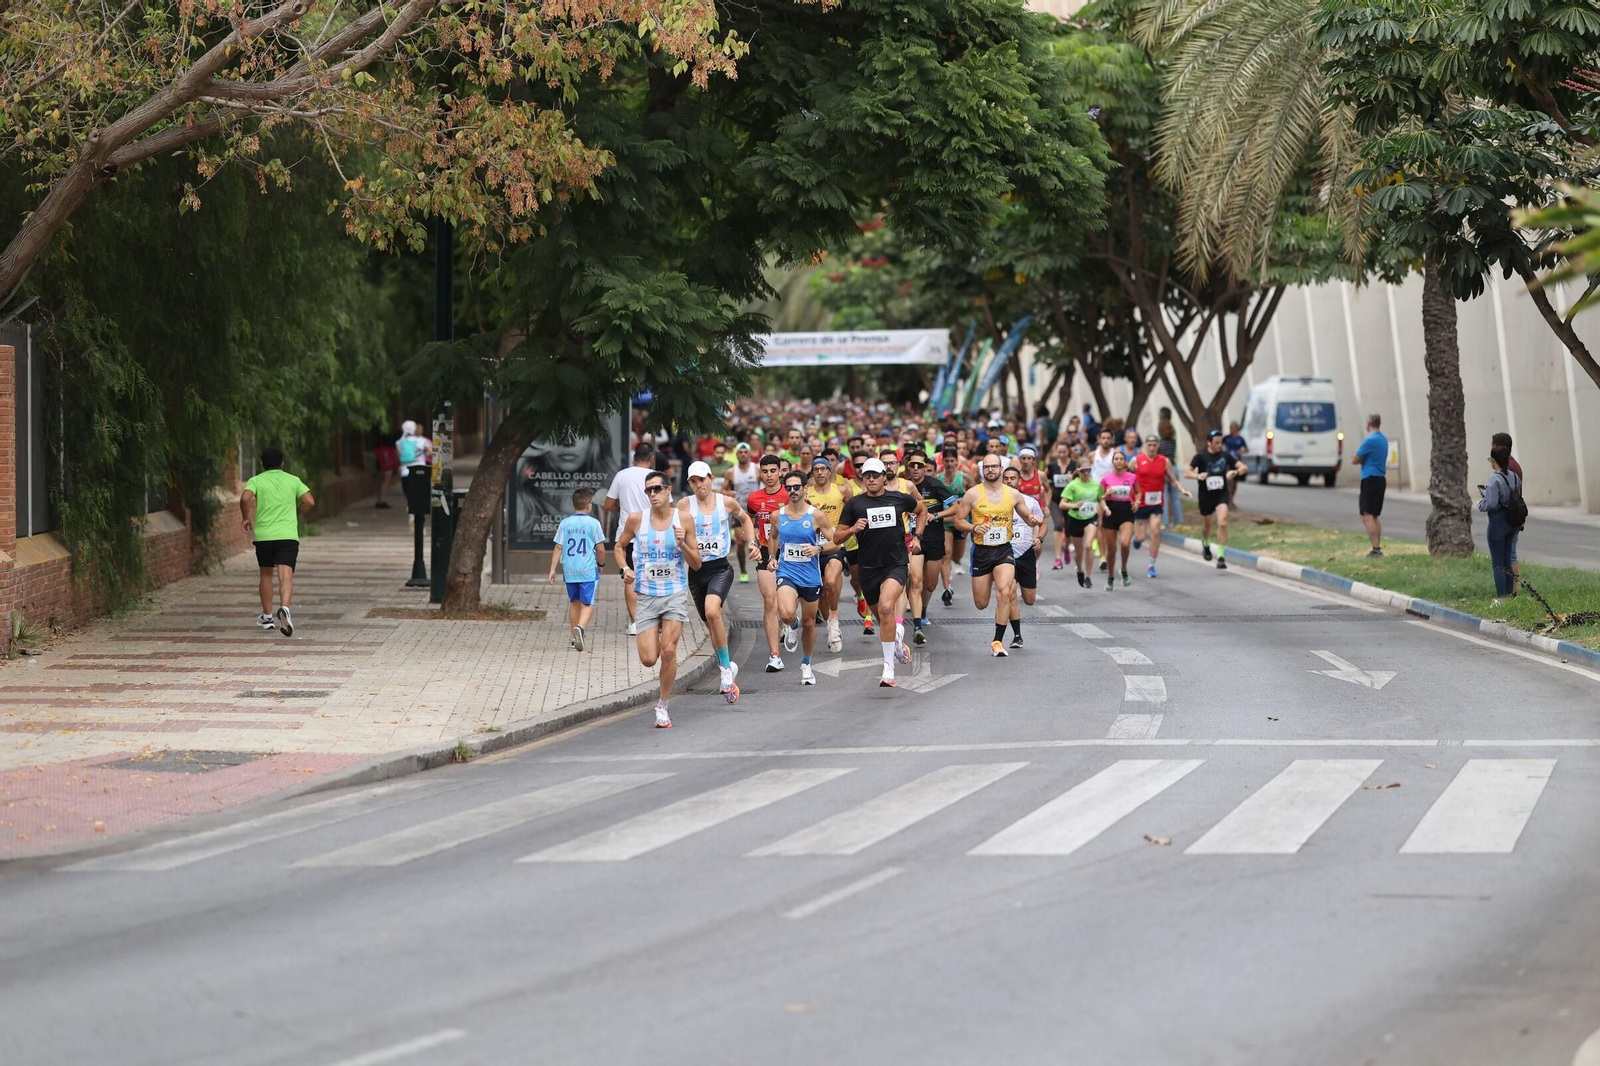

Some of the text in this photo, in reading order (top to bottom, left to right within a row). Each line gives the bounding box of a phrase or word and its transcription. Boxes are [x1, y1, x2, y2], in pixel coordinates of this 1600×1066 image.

[528, 472, 608, 480] CABELLO GLOSSY
[871, 513, 892, 522] 859
[989, 532, 1001, 540] 33
[567, 537, 587, 557] 24
[698, 542, 719, 550] 344
[649, 568, 671, 577] 125
